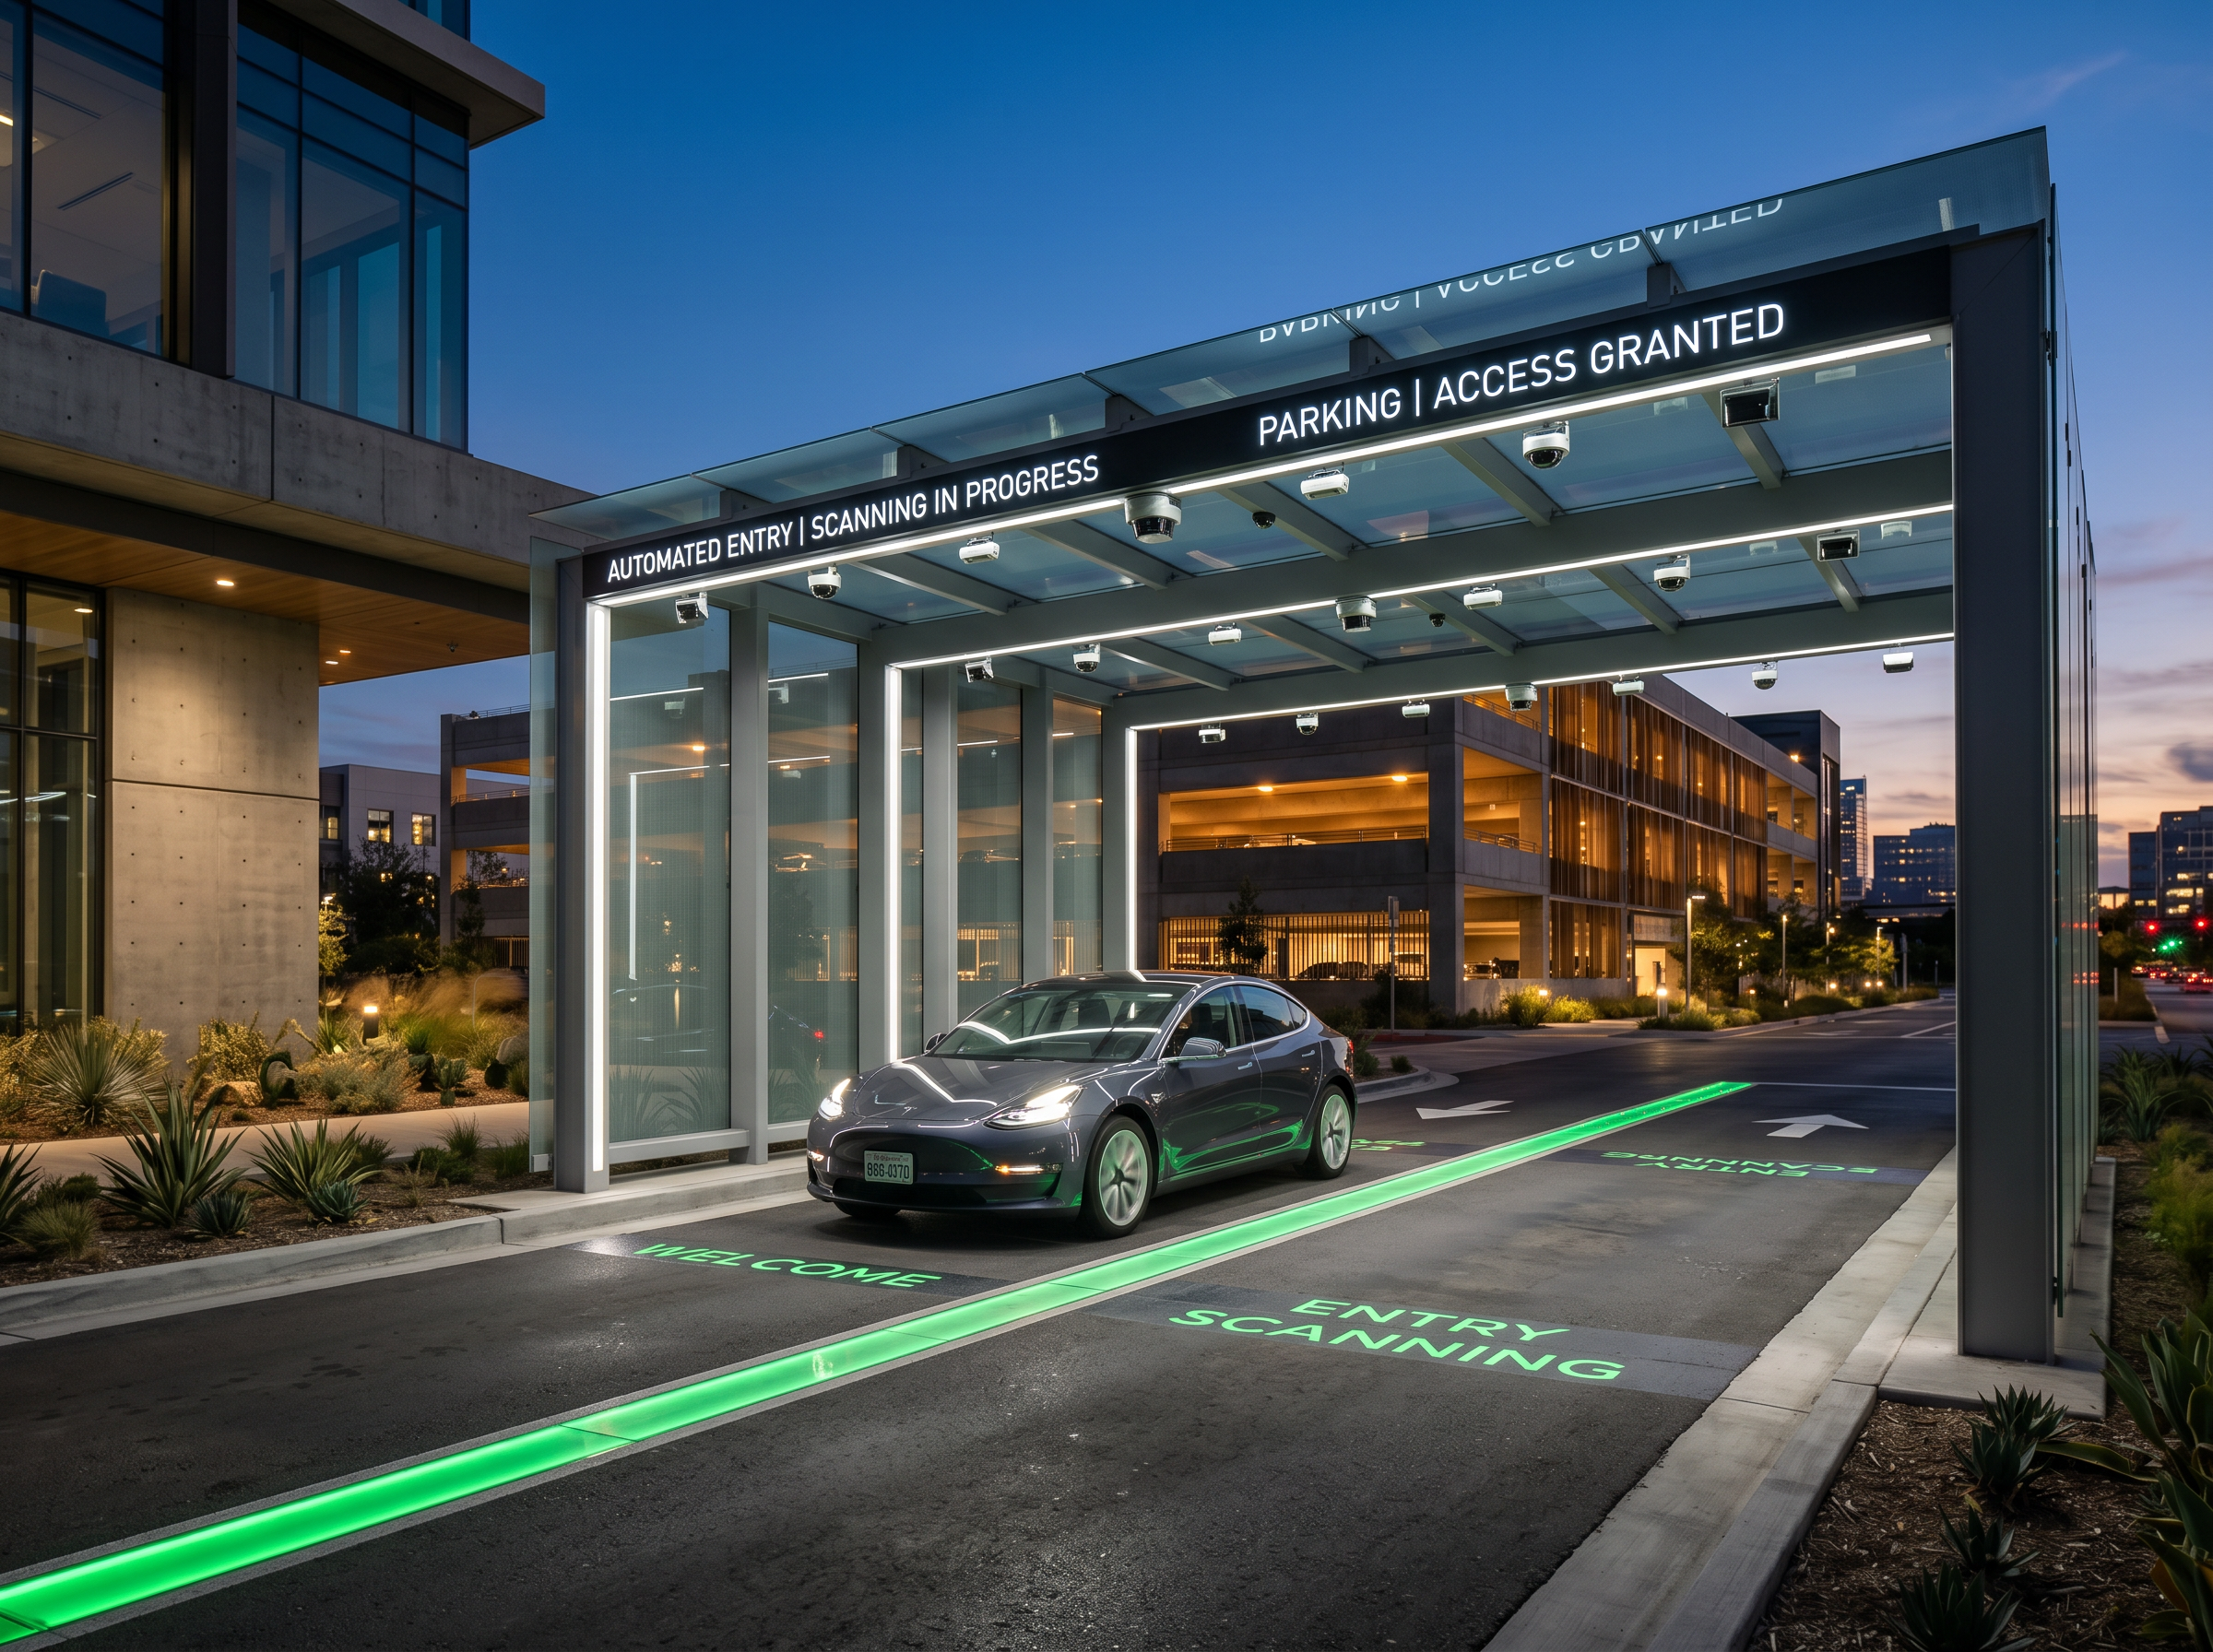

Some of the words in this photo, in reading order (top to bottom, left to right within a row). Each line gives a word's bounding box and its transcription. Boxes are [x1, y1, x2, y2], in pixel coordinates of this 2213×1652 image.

[1260, 387, 1402, 446] PARKING
[1433, 348, 1577, 409] ACCESS
[1590, 303, 1785, 374] GRANTED
[607, 537, 722, 584] AUTOMATED
[728, 521, 794, 559] ENTRY
[811, 492, 928, 540] SCANNING
[934, 485, 958, 515] IN
[966, 454, 1099, 508] PROGRESS
[633, 1244, 942, 1288] WELCOME
[1168, 1309, 1626, 1380] SCANNING
[1290, 1299, 1569, 1341] ENTRY
